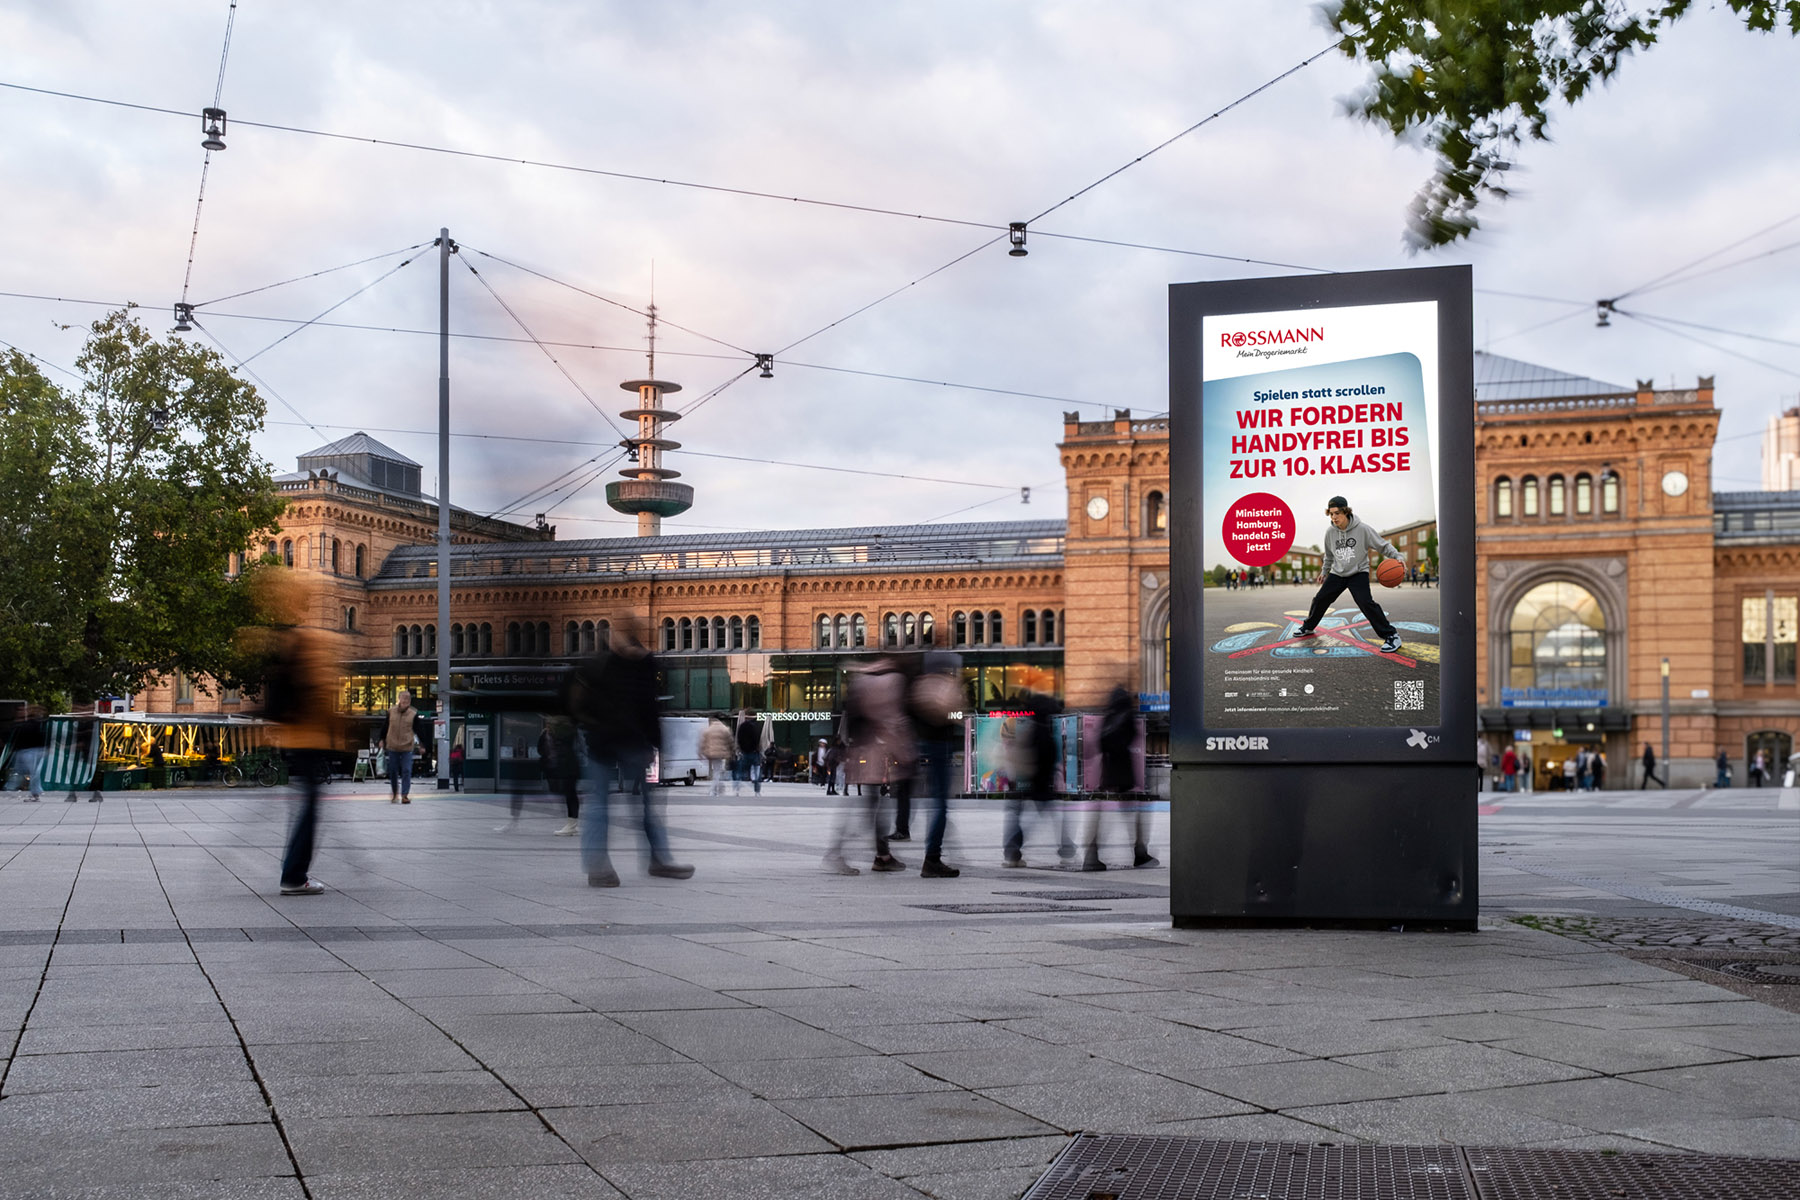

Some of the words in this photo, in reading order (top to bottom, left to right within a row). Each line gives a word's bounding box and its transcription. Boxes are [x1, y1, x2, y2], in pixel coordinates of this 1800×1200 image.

[1221, 327, 1324, 347] ROSSMANN
[1236, 350, 1254, 358] Mein
[1254, 346, 1308, 360] Drogeriemarkt
[1253, 389, 1299, 403] Spielen
[1302, 387, 1332, 399] statt
[1335, 384, 1385, 397] scrollen
[1236, 408, 1283, 429] WIR
[1290, 402, 1403, 427] FORDERN
[1231, 429, 1363, 454] HANDYFREI
[1371, 426, 1409, 448] BIS
[1230, 458, 1276, 479] ZUR
[1282, 456, 1316, 476] 10.
[1320, 451, 1411, 475] KLASSE
[1235, 508, 1282, 518] Ministerin
[1236, 520, 1281, 530] Hamburg,
[1232, 531, 1270, 541] handeln
[1271, 530, 1286, 539] Sie
[1246, 542, 1271, 553] jetzt!
[472, 674, 502, 684] Tickets
[512, 674, 544, 684] Service
[801, 711, 831, 721] HOUSE
[1205, 735, 1269, 751] STRÖER
[1427, 735, 1440, 744] CM
